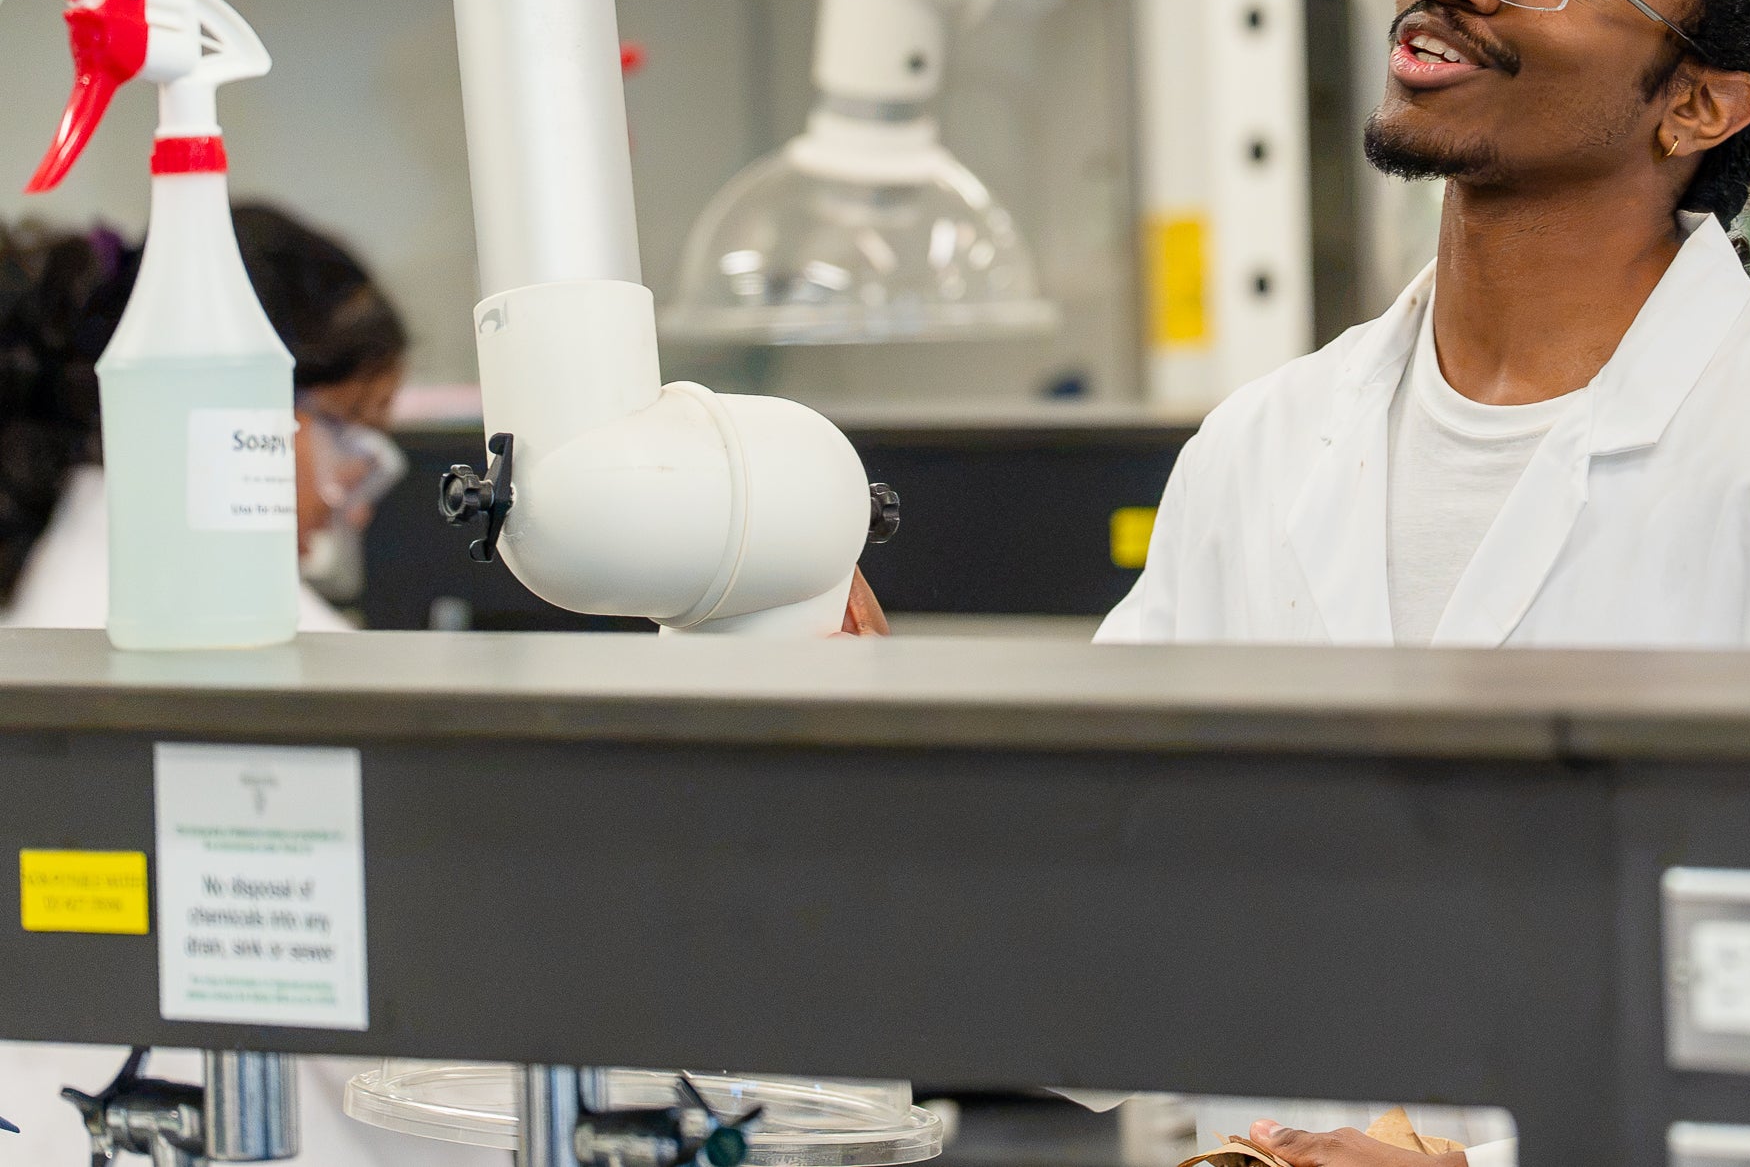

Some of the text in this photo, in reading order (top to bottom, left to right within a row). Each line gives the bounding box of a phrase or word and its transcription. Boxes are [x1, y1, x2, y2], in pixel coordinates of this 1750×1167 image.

[232, 429, 287, 458] Soapy
[202, 874, 222, 897] No
[231, 875, 292, 901] disposal
[189, 906, 264, 930] chemicals
[231, 939, 263, 959] sink
